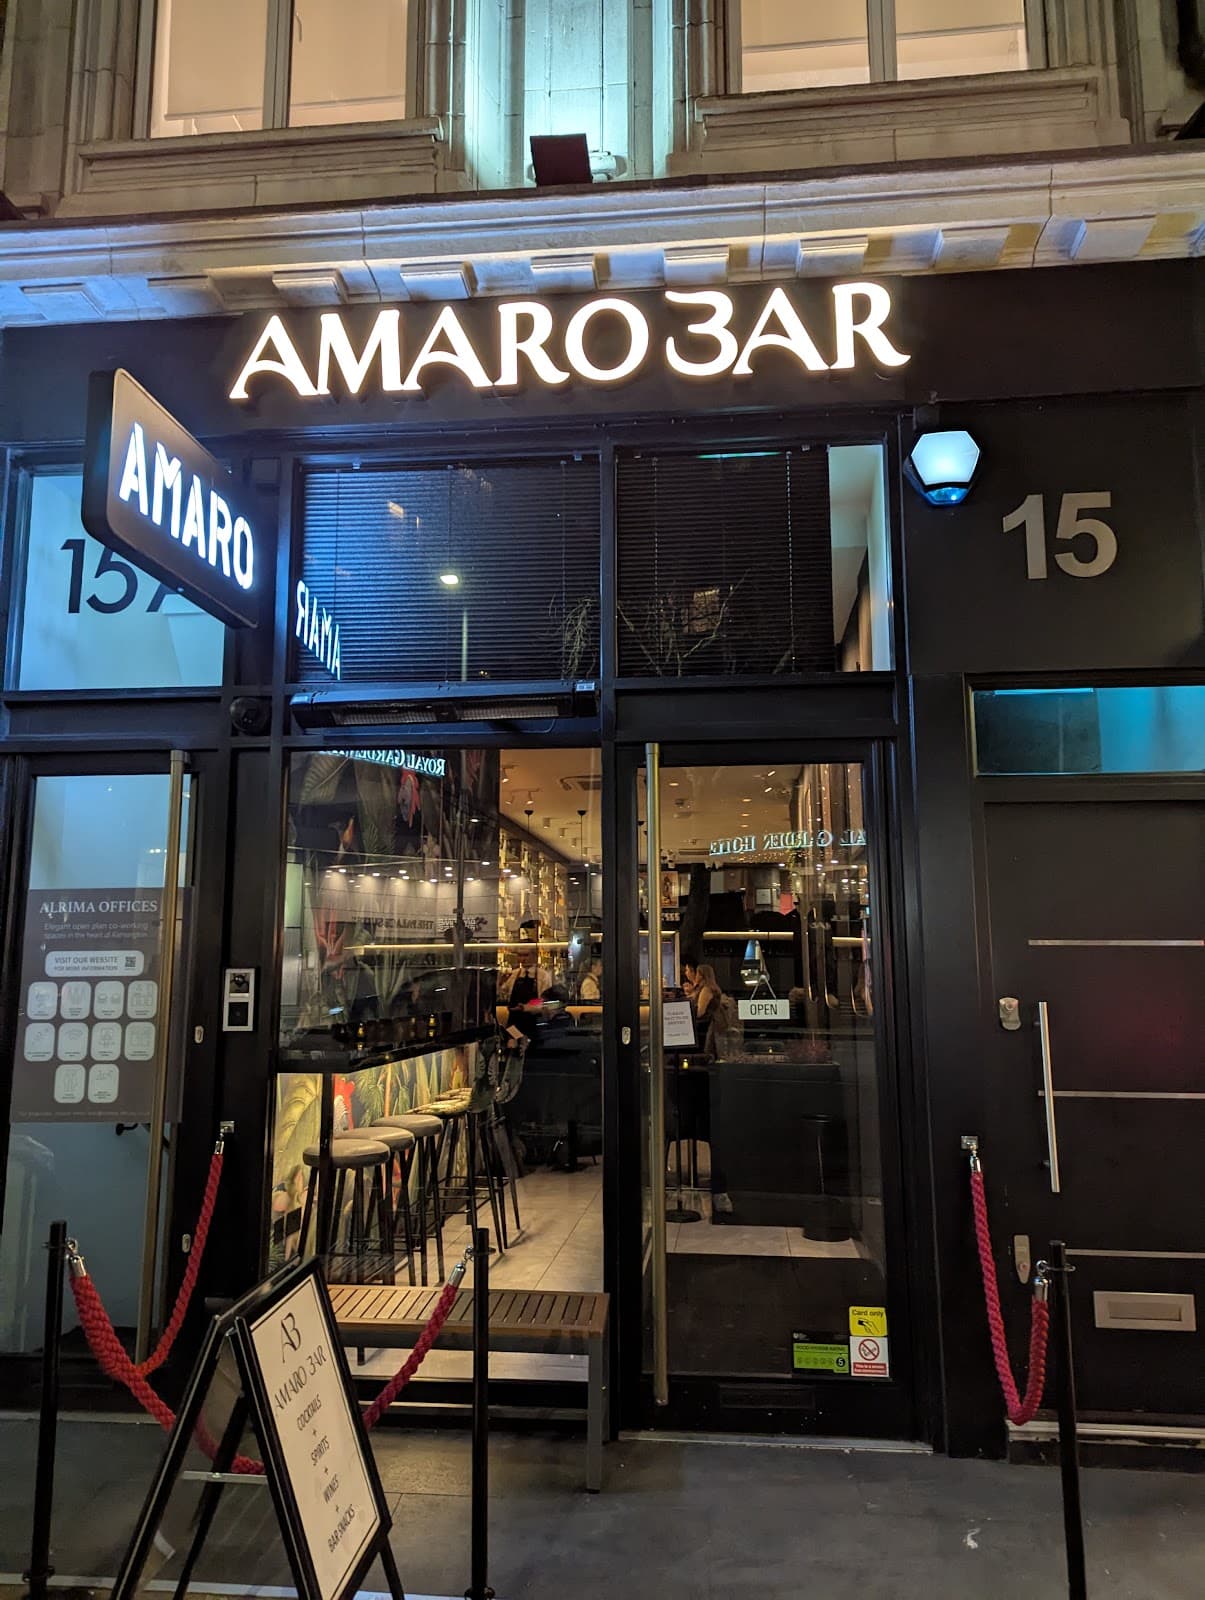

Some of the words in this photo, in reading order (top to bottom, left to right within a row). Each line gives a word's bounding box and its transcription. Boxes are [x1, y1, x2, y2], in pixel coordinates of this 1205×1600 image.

[228, 296, 650, 400] AMARO
[118, 423, 254, 590] AMARO
[1002, 491, 1118, 580] 15
[40, 901, 95, 913] ALRIMA
[98, 900, 158, 912] OFFICES
[750, 1003, 778, 1016] OPEN
[296, 1393, 322, 1431] COCKTAILS
[310, 1435, 330, 1467] SPIRITS
